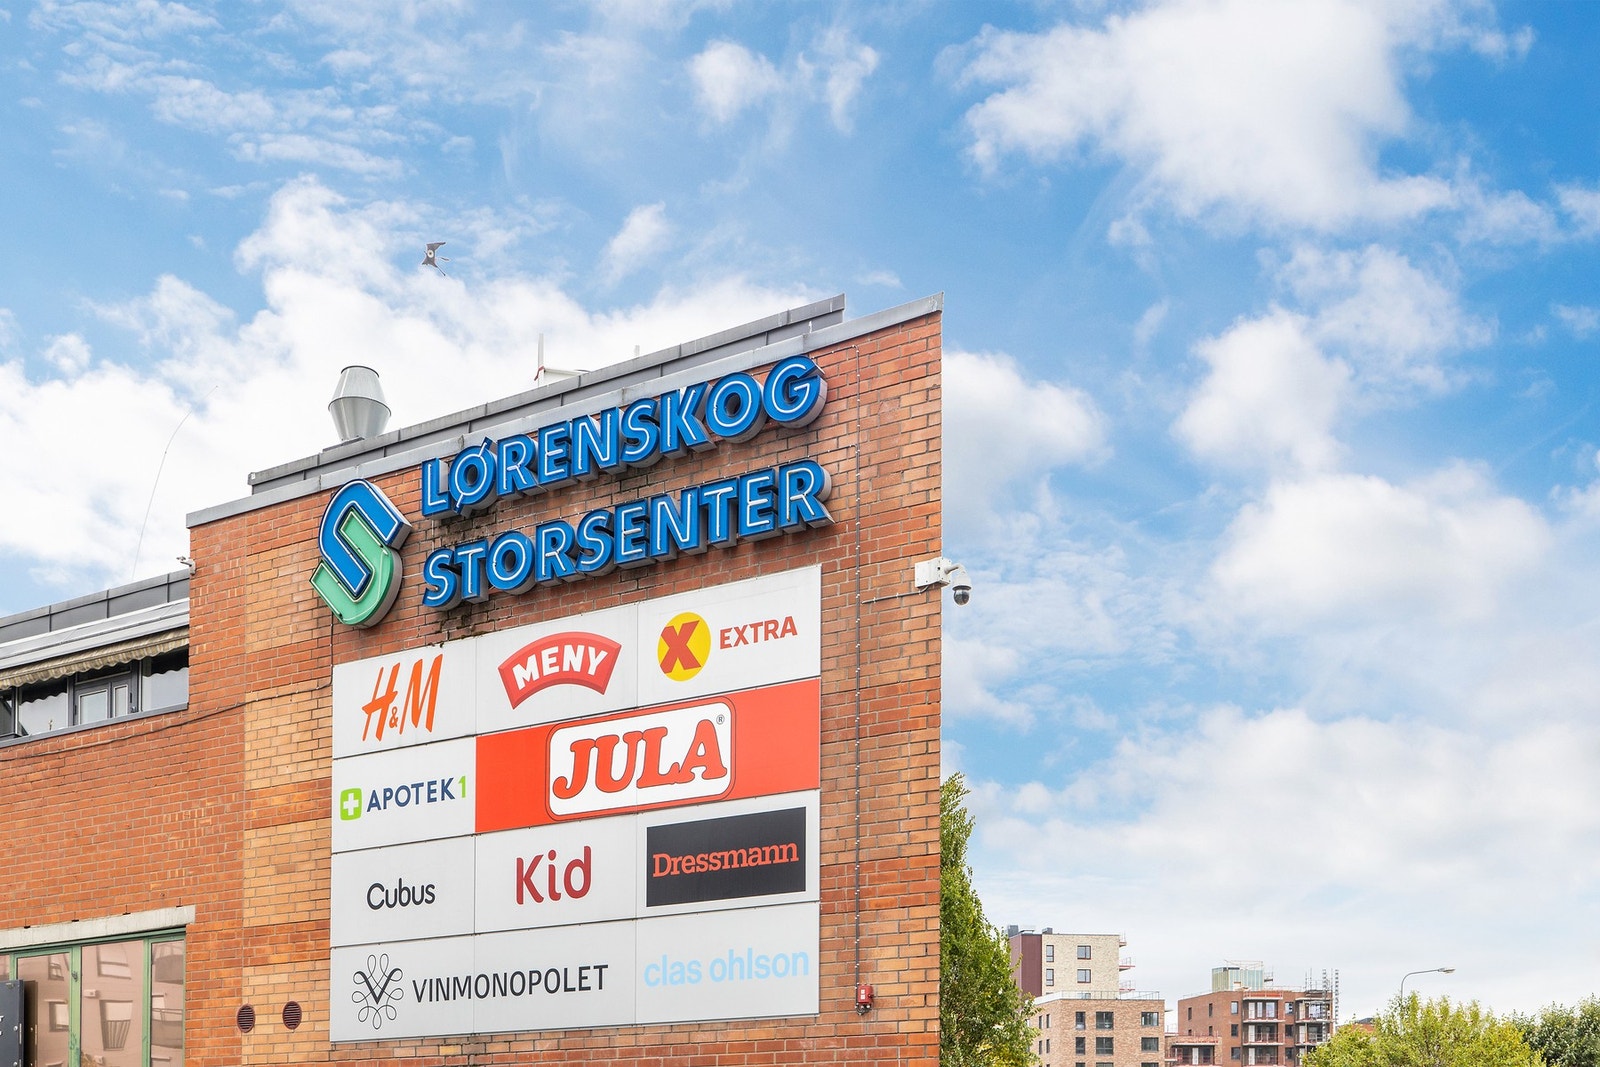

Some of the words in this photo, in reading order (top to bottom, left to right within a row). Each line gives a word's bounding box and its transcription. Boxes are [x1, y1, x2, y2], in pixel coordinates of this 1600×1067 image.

[421, 355, 828, 517] LØRENSKOG
[422, 459, 834, 608] STORSENTER
[719, 615, 798, 650] EXTRA
[512, 644, 608, 688] MENY
[362, 653, 443, 742] H&M
[552, 719, 728, 800] JULA
[515, 845, 592, 905] Kid
[652, 841, 799, 878] Dressmann
[366, 877, 436, 911] Cubus
[412, 964, 609, 1003] VINMONOPOLET
[643, 953, 702, 988] clas
[709, 947, 809, 982] ohlson
